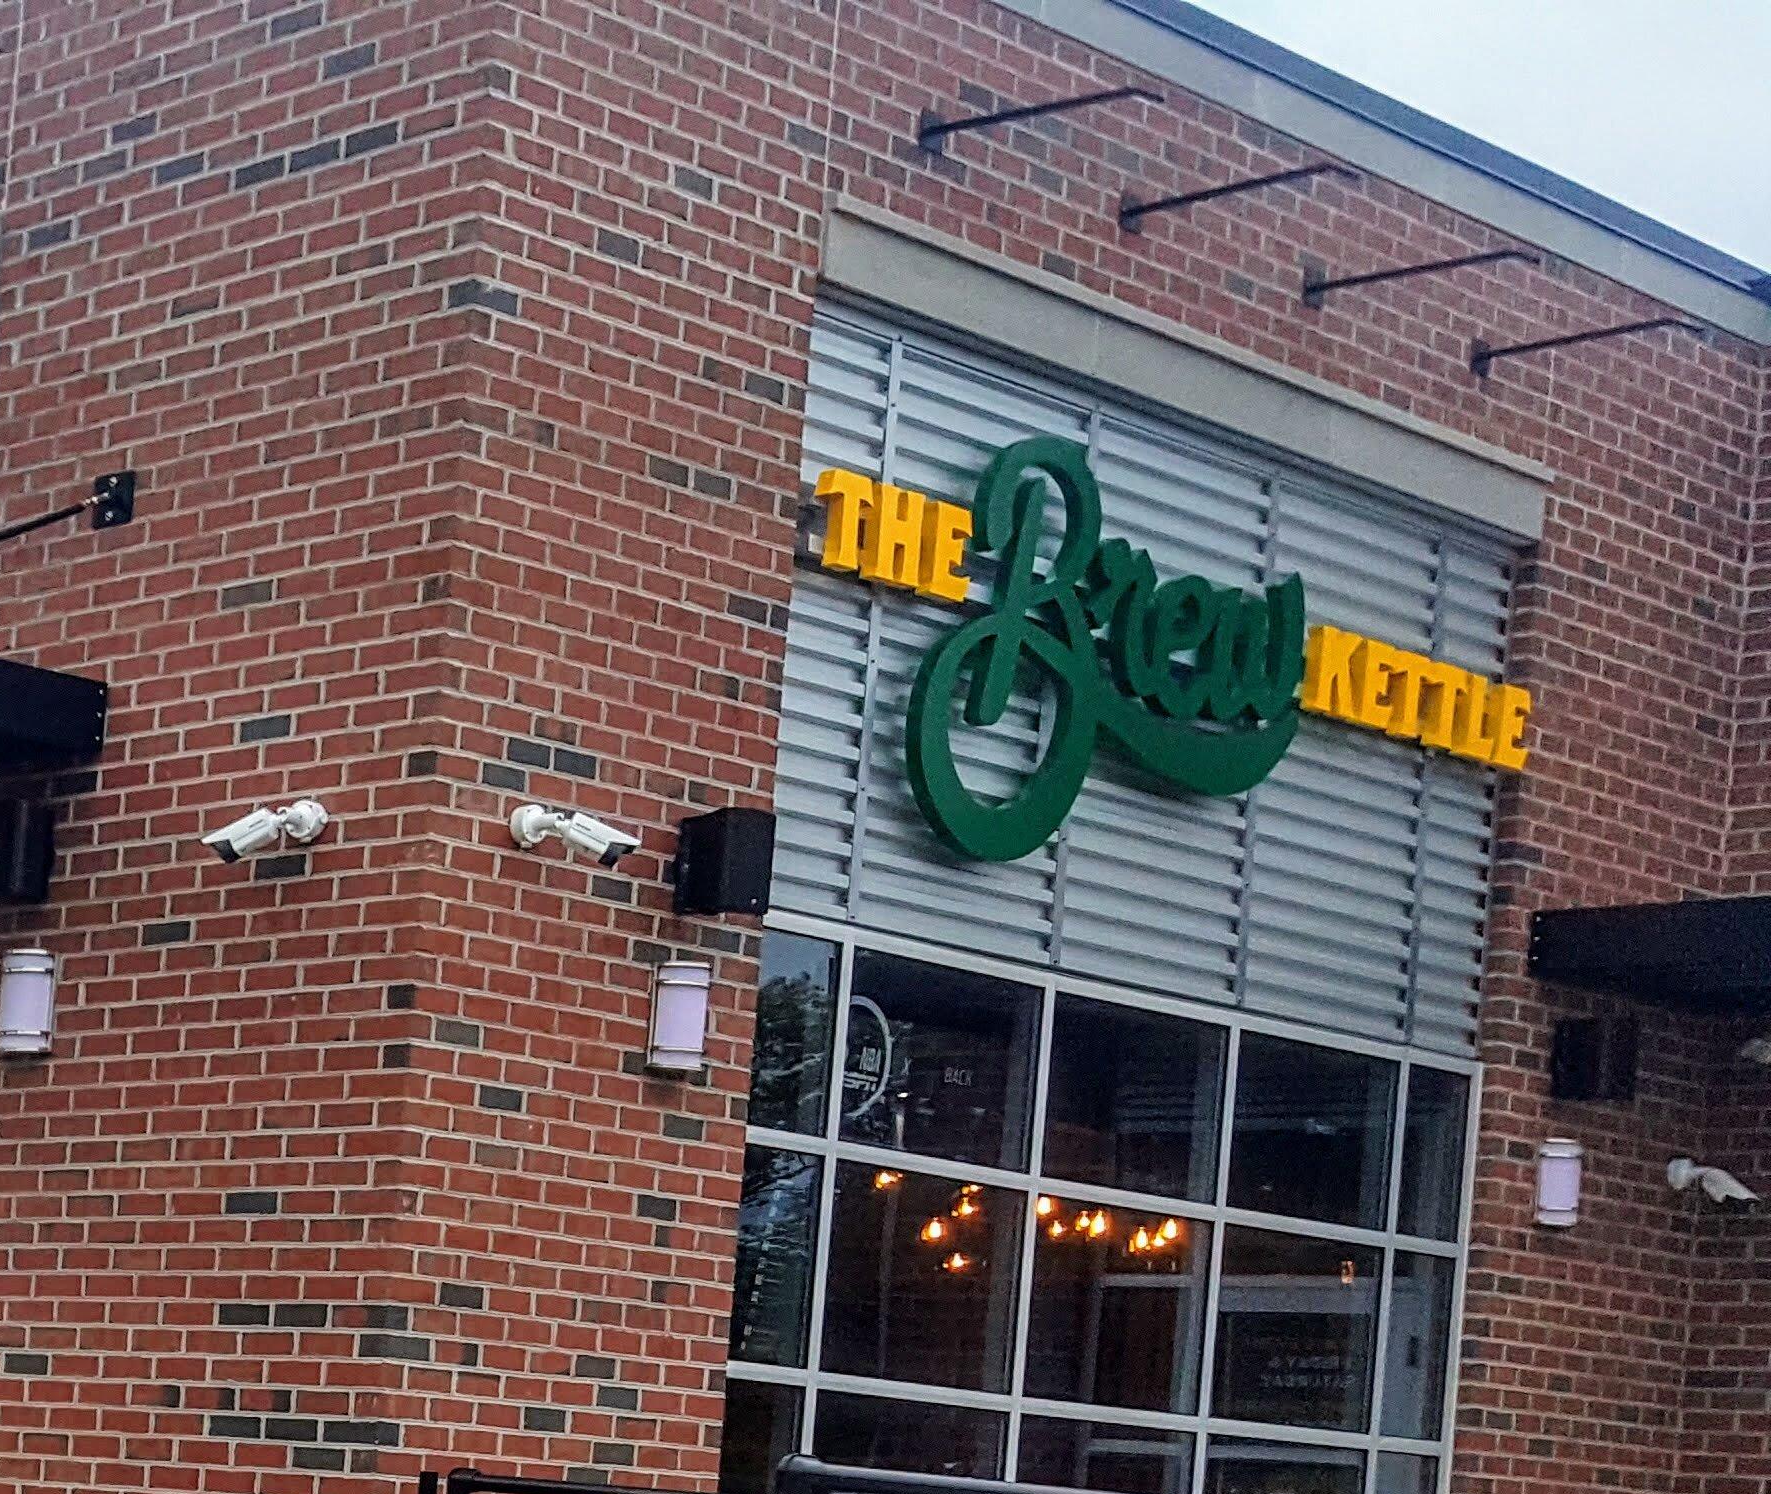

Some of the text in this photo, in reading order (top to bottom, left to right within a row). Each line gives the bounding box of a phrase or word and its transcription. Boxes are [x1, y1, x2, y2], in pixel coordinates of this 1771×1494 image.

[813, 436, 1532, 861] THE Brew KETTLE
